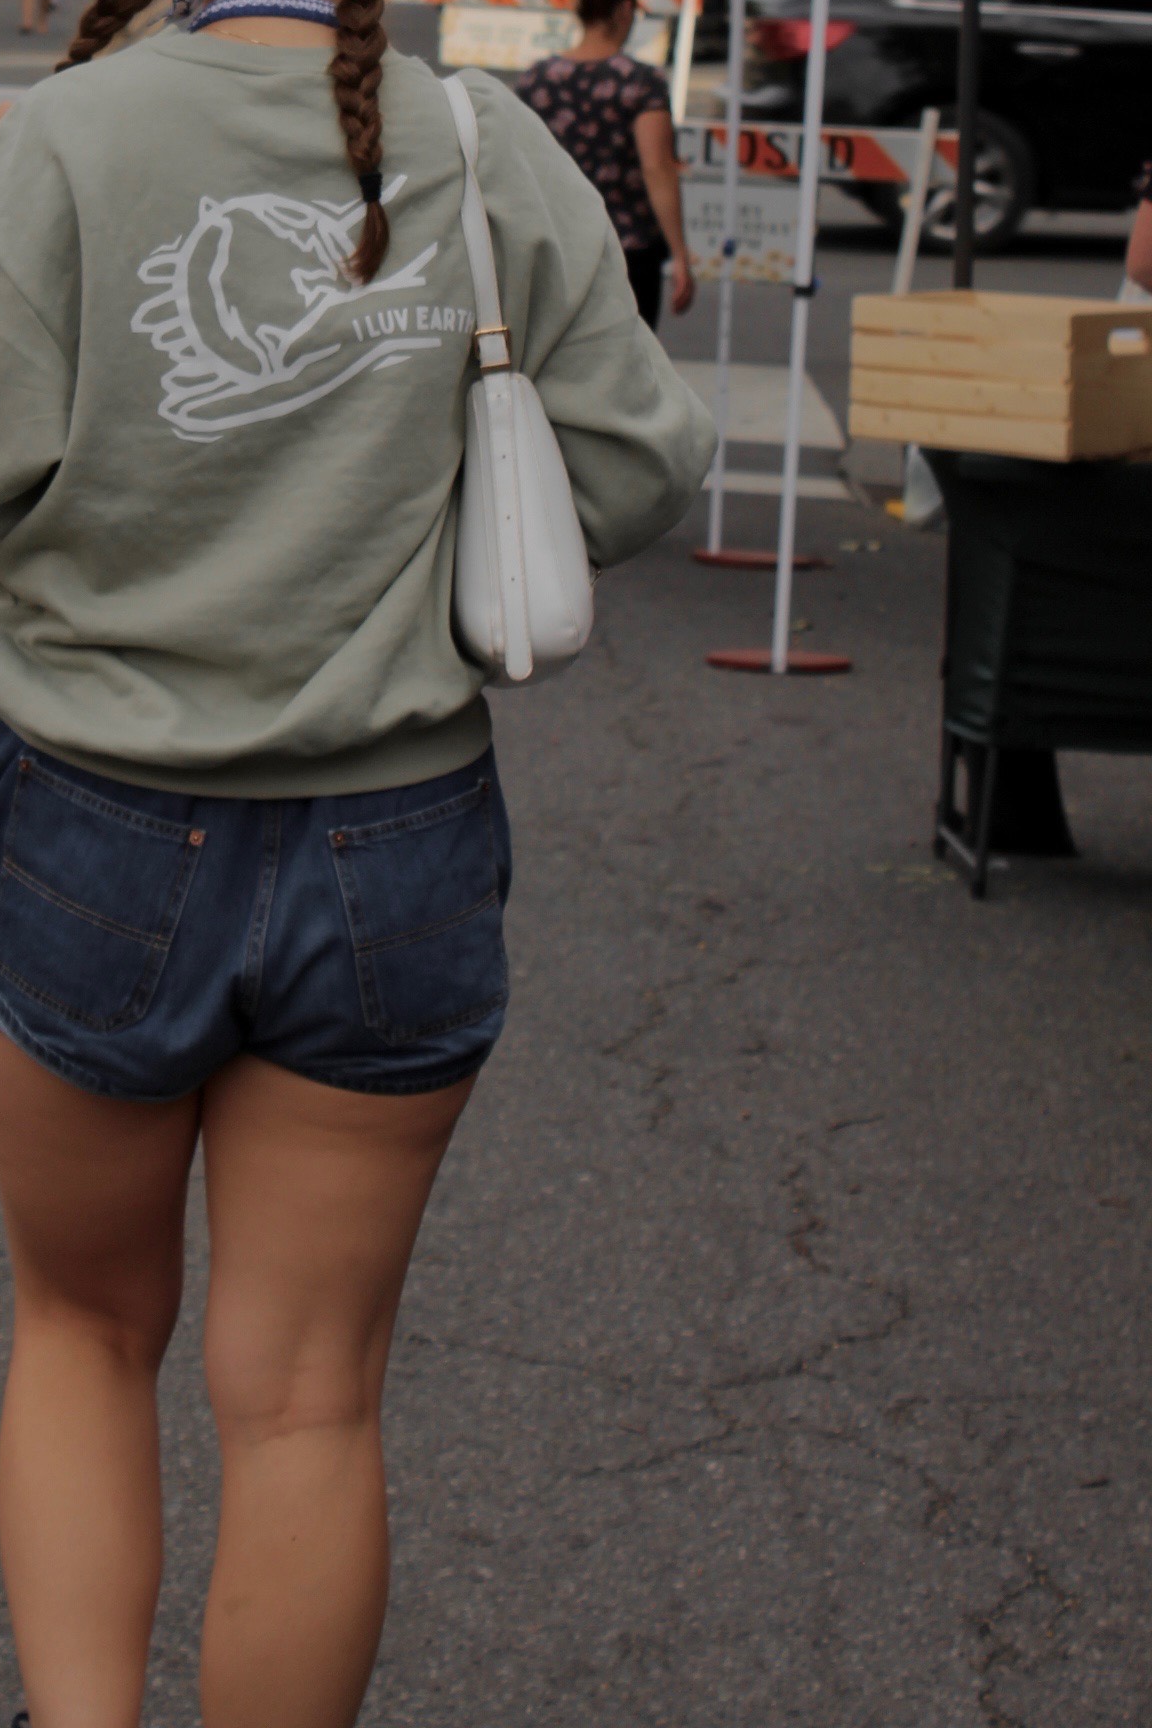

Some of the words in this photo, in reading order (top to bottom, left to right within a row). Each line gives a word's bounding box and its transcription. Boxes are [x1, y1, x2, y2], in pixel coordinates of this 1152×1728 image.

[672, 127, 855, 172] CLOSD
[352, 319, 364, 342] I
[364, 308, 408, 338] LUV
